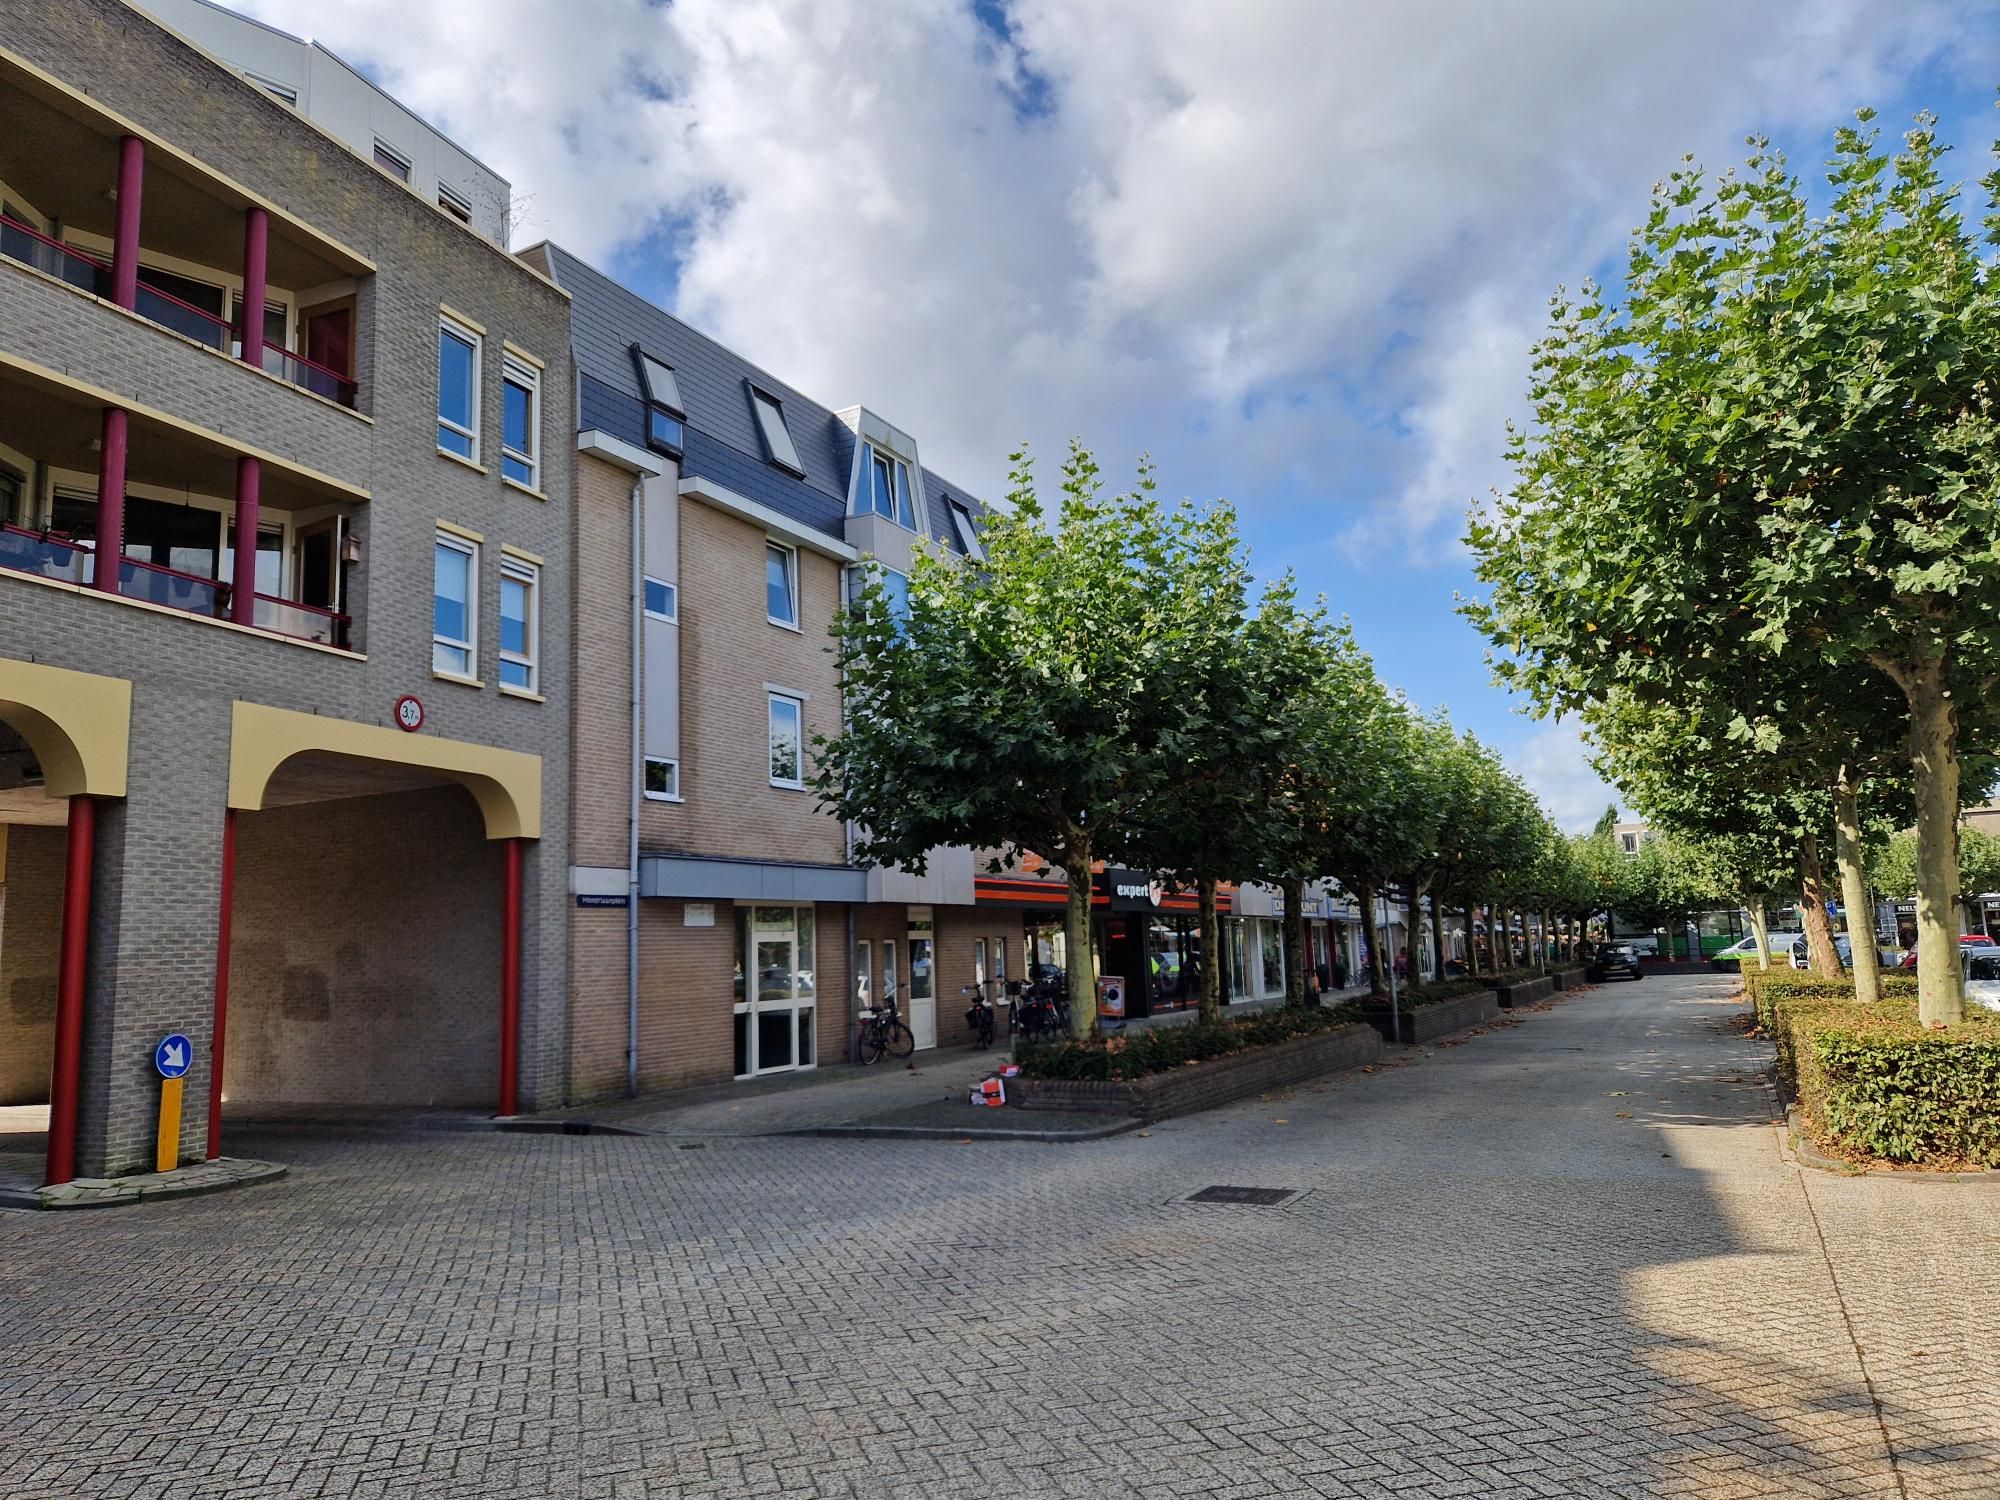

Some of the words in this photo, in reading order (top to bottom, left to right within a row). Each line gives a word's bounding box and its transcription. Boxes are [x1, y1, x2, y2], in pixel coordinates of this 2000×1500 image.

[1117, 884, 1149, 899] expert
[582, 896, 626, 905] Mondriaanplein
[1274, 900, 1318, 912] DIUNT
